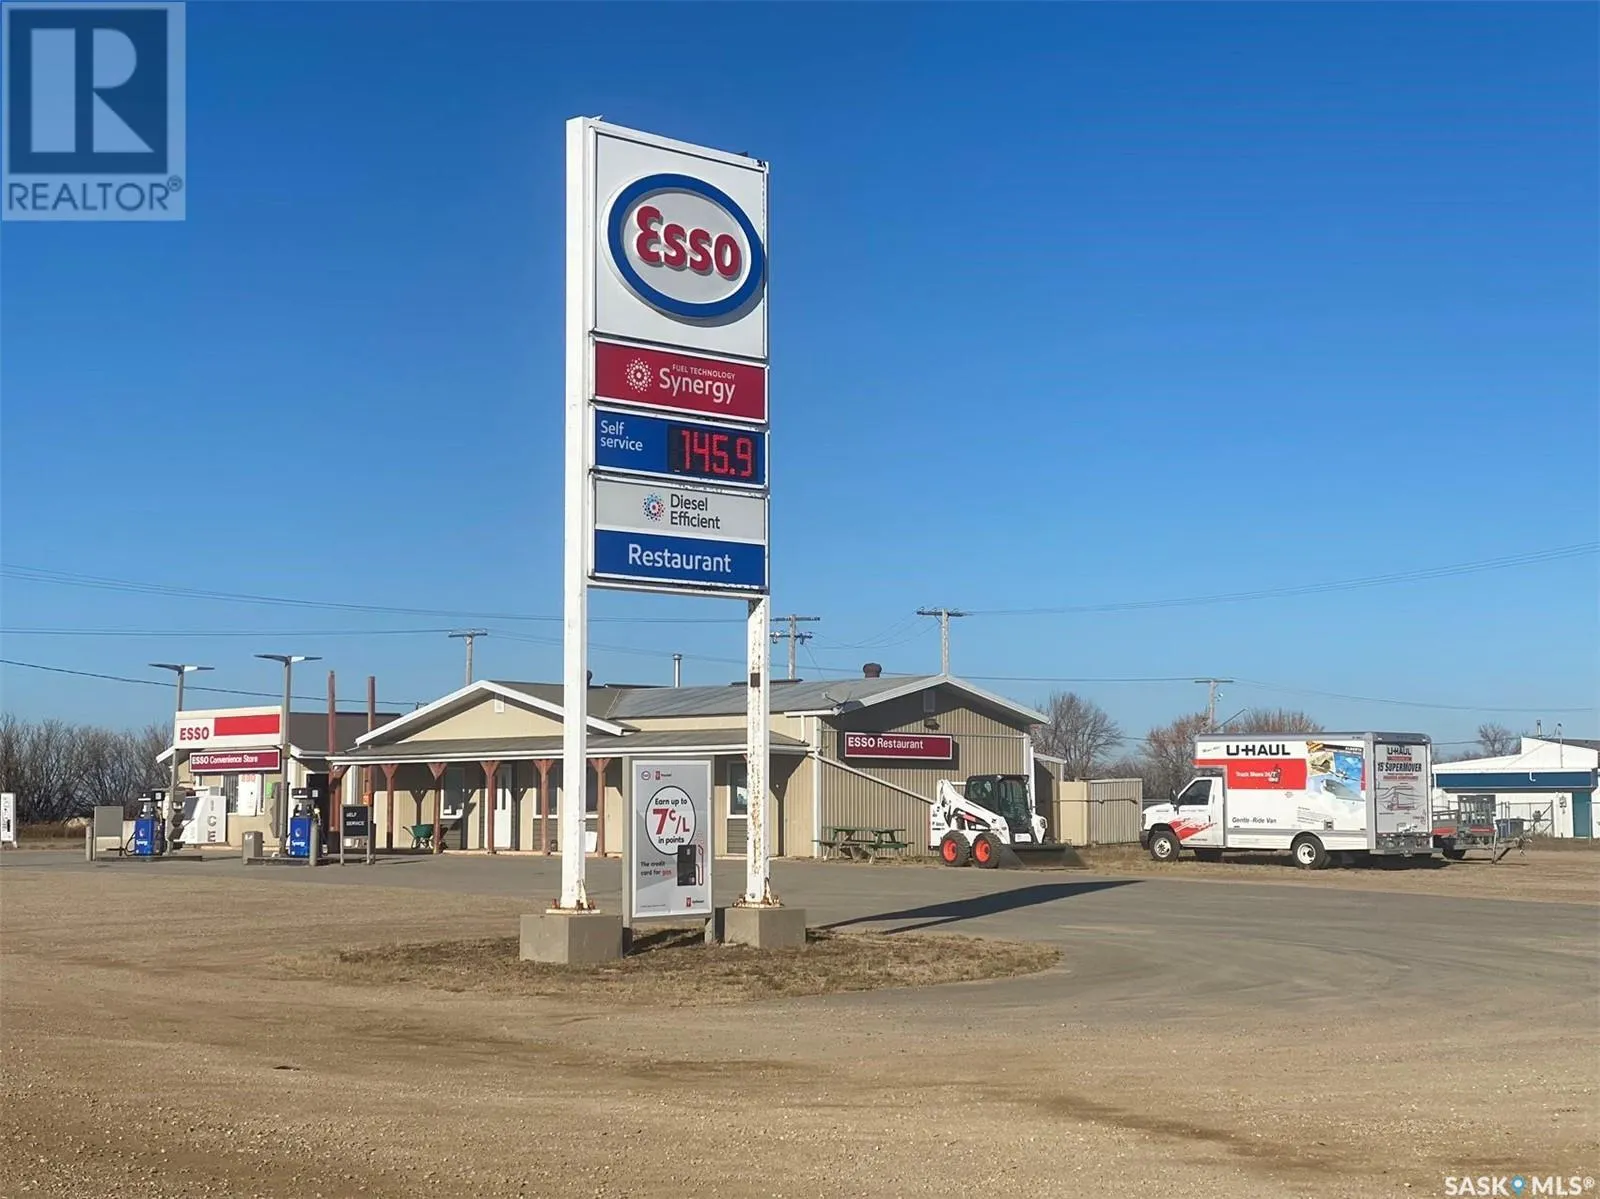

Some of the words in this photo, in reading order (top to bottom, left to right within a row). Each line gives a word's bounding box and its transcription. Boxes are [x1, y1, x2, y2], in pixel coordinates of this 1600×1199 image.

[672, 364, 688, 373] FUEL
[690, 367, 736, 380] TECHNOLOGY
[659, 367, 736, 404] Synergy
[600, 420, 625, 436] Self
[600, 436, 643, 451] service
[681, 429, 754, 478] 145.9
[670, 493, 708, 512] Diesel
[670, 511, 721, 530] Efficient
[628, 543, 732, 573] Restaurant
[180, 727, 209, 740] ESSO
[848, 737, 875, 747] ESSO
[877, 737, 924, 749] Restaurant
[1226, 744, 1290, 756] U-HAUL
[191, 756, 208, 764] ESSO
[209, 754, 242, 764] Convenience
[243, 754, 258, 763] Store
[665, 836, 684, 846] points
